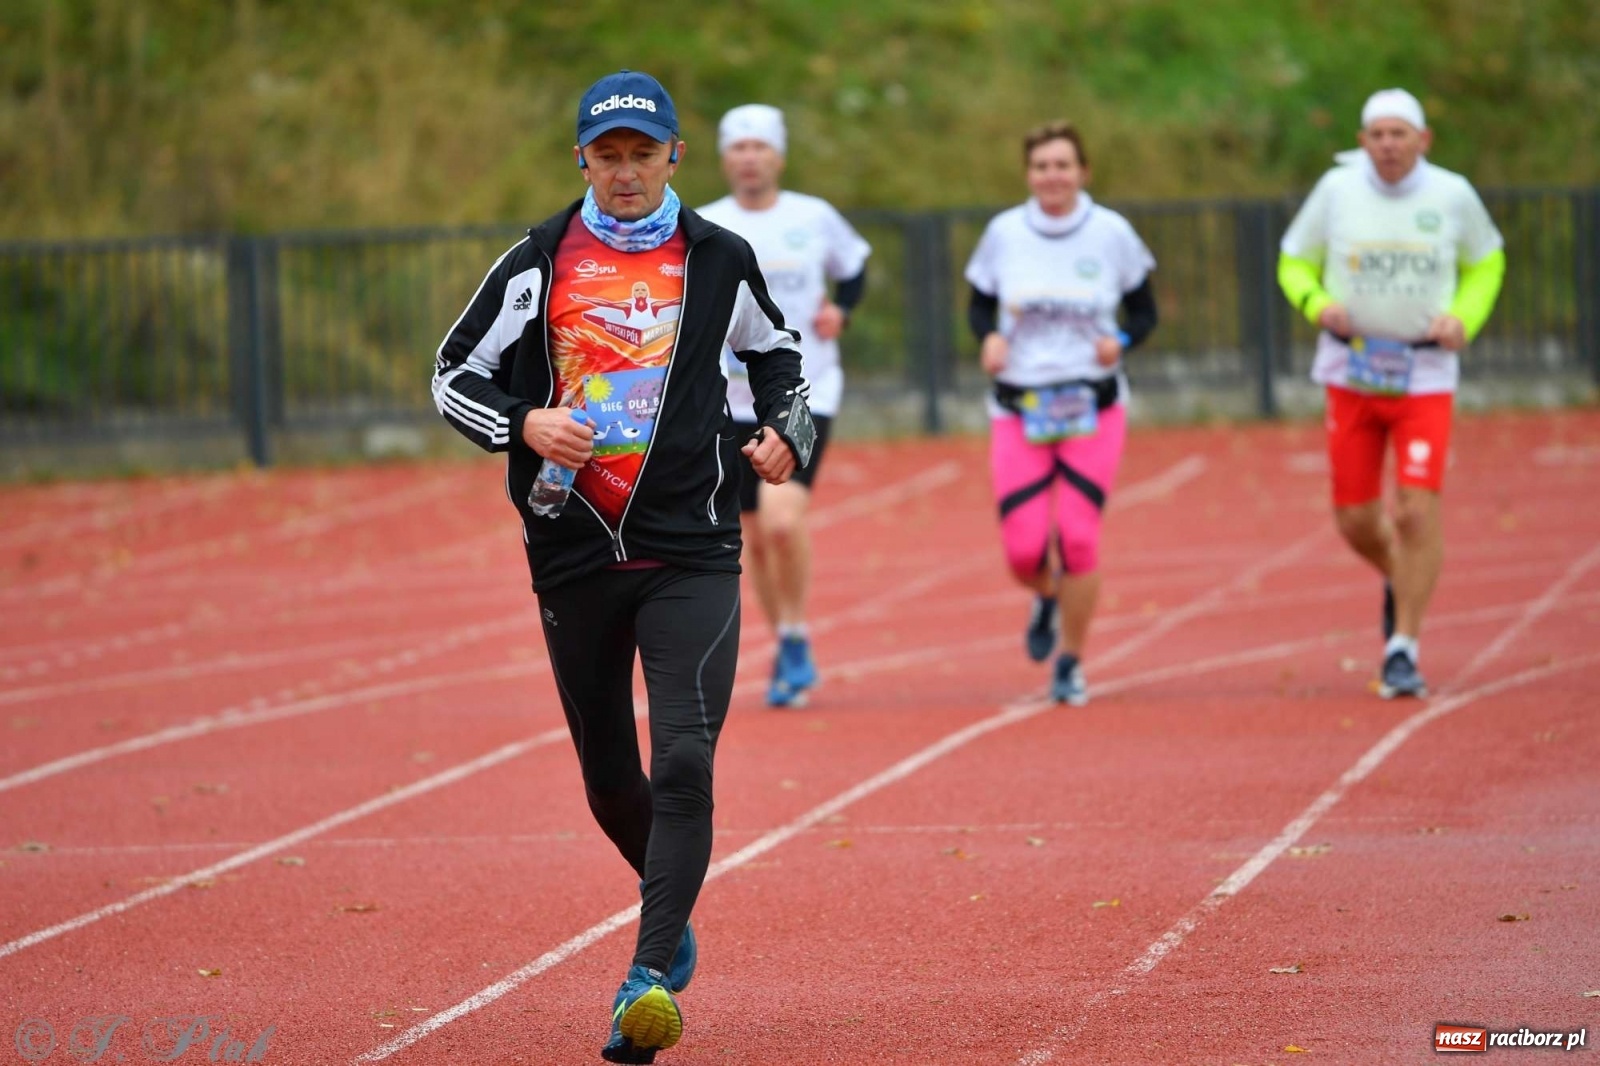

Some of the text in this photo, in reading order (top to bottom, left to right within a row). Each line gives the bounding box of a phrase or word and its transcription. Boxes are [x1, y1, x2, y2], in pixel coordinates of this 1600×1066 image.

[590, 94, 656, 116] adidas
[598, 265, 617, 275] SPLA
[626, 329, 640, 344] PÓŁ
[601, 401, 623, 413] BIEG
[628, 398, 648, 410] DLA
[601, 468, 628, 490] TYCH
